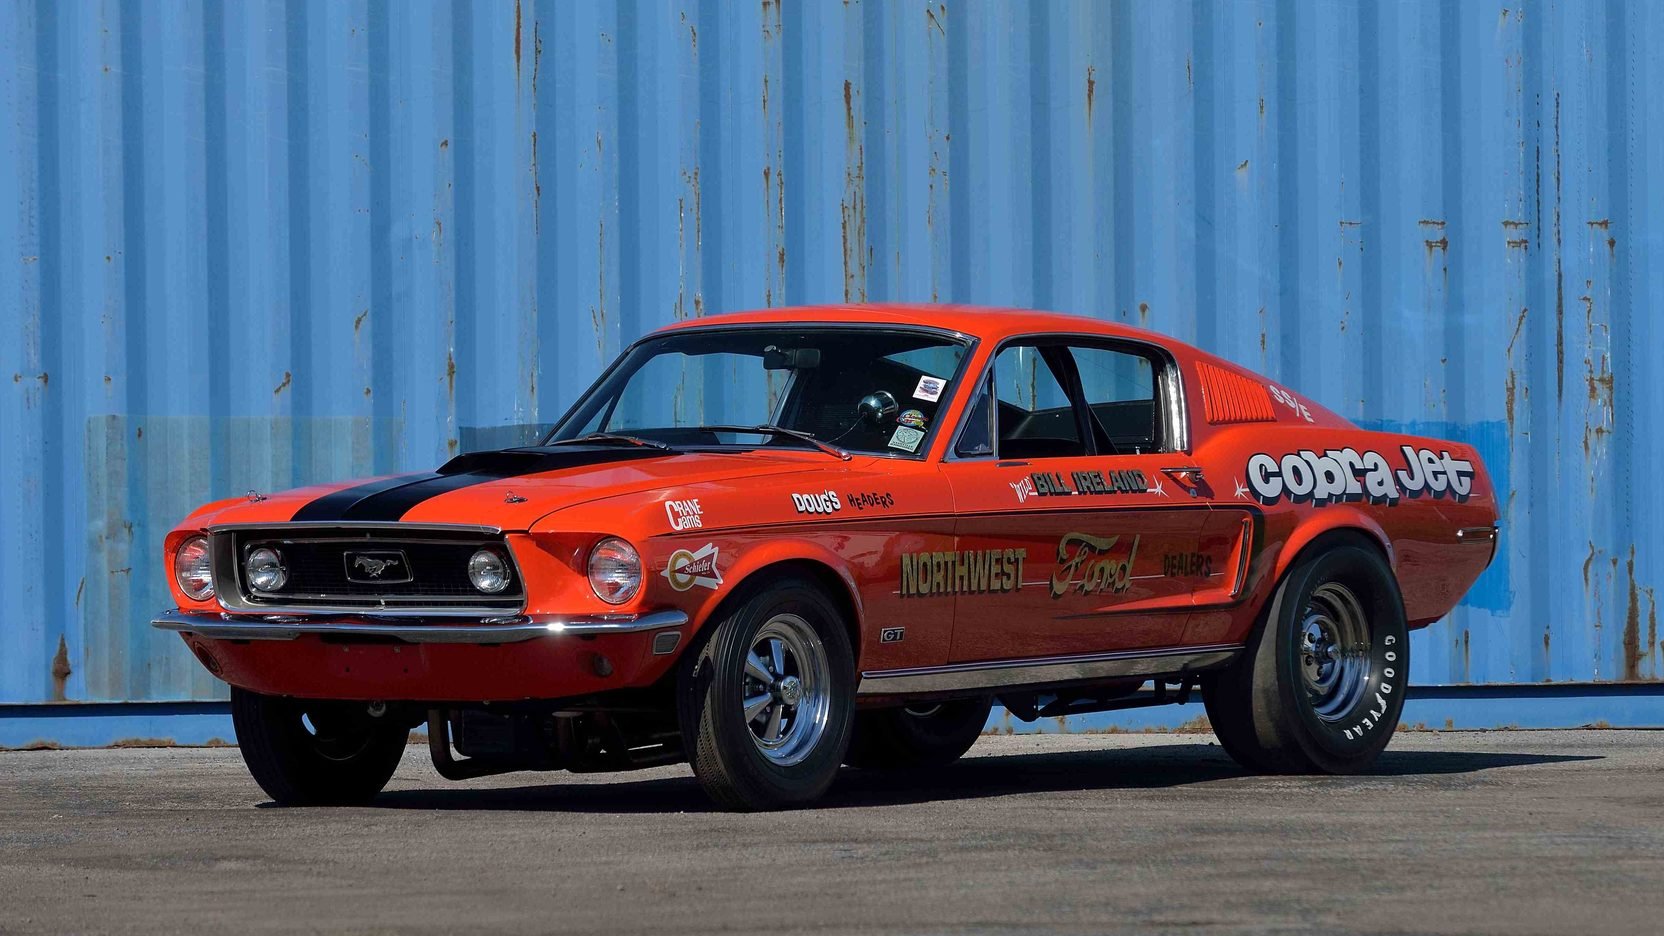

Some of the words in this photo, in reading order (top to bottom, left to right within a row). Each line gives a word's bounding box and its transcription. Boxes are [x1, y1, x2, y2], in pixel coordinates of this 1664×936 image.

[1269, 385, 1314, 423] SS/E
[1031, 472, 1073, 496] BILL
[1071, 470, 1148, 495] IRELAND
[791, 489, 841, 514] DOUG'S
[847, 492, 895, 510] HEADERS
[901, 548, 1026, 597] NORTHWEST
[1051, 532, 1141, 598] Ford
[1163, 552, 1212, 577] DEALERS
[884, 629, 904, 641] GT
[1343, 635, 1396, 740] GOODYEAR
